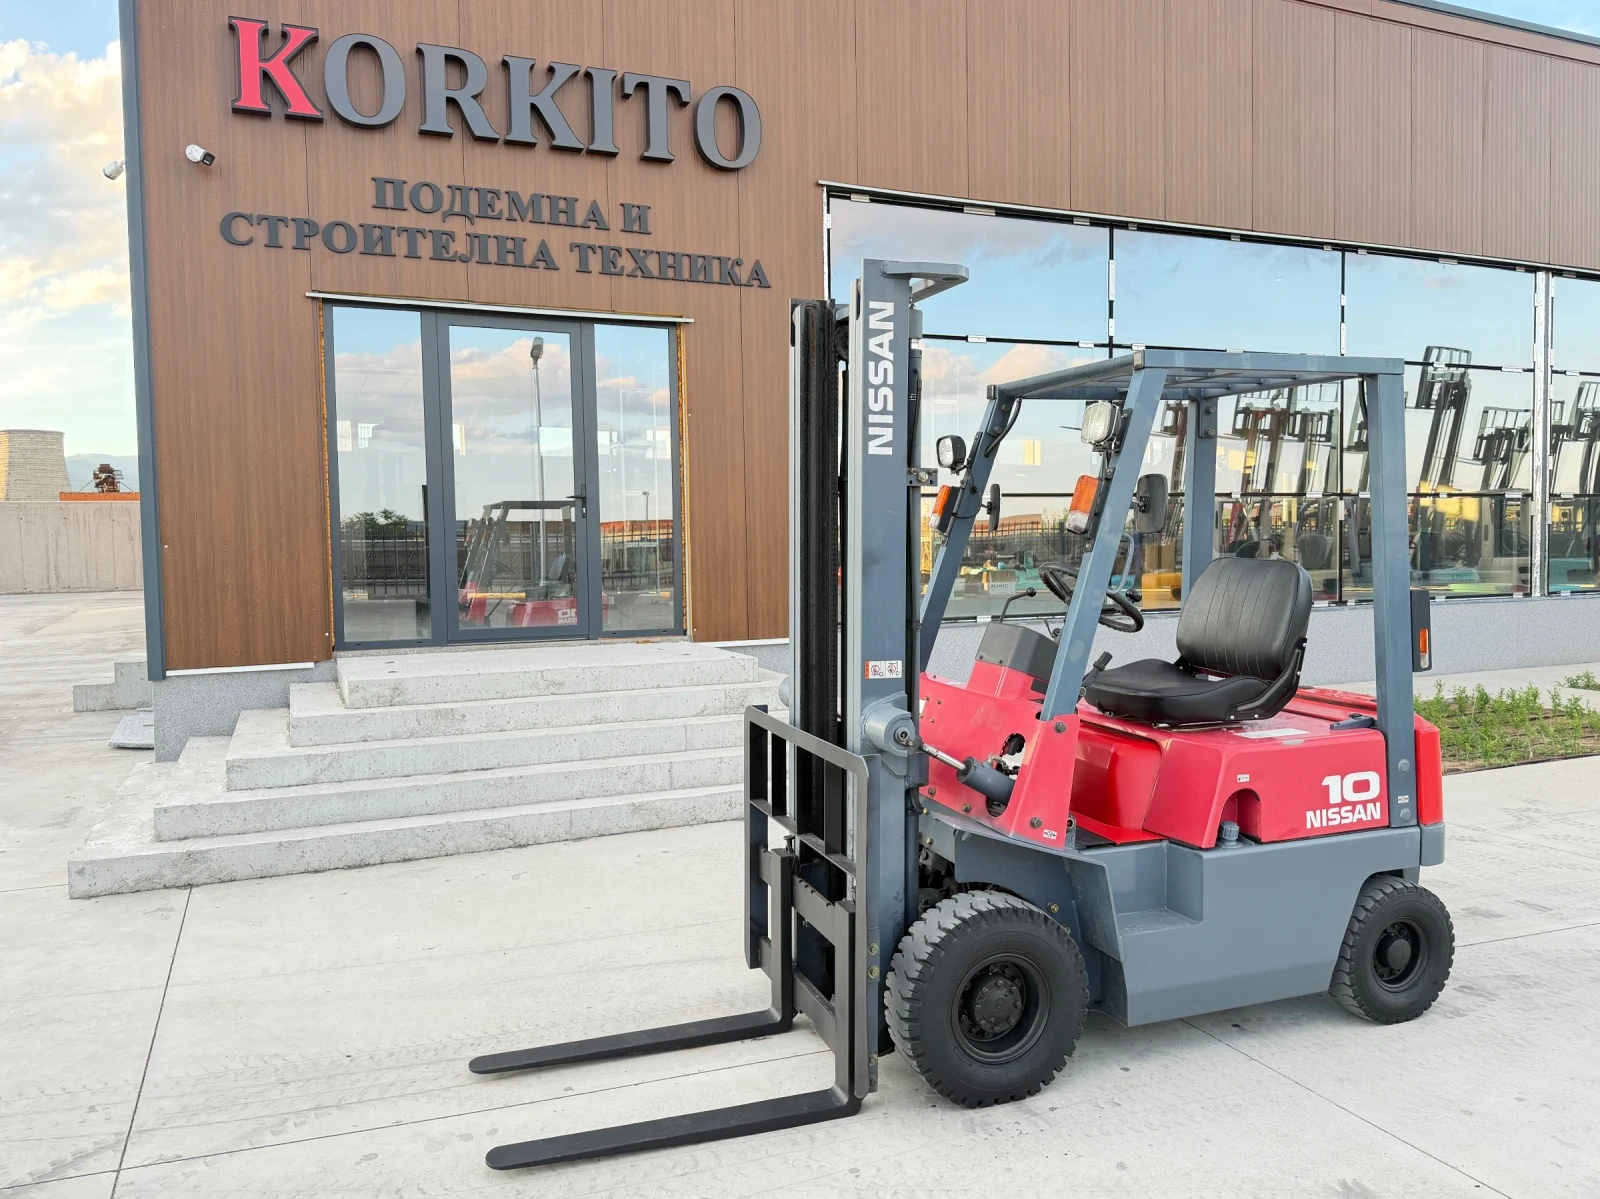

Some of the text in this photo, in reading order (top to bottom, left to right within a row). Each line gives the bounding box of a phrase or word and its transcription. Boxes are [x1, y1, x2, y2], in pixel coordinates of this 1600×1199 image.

[228, 16, 762, 171] KORKITO
[371, 176, 652, 235] ПОДЕМНА И
[220, 211, 771, 288] СТРОИТЕЛНА ТЕХНИКА
[868, 301, 894, 455] NISSAN
[1306, 802, 1381, 829] NISSAN
[1321, 770, 1380, 804] 10
